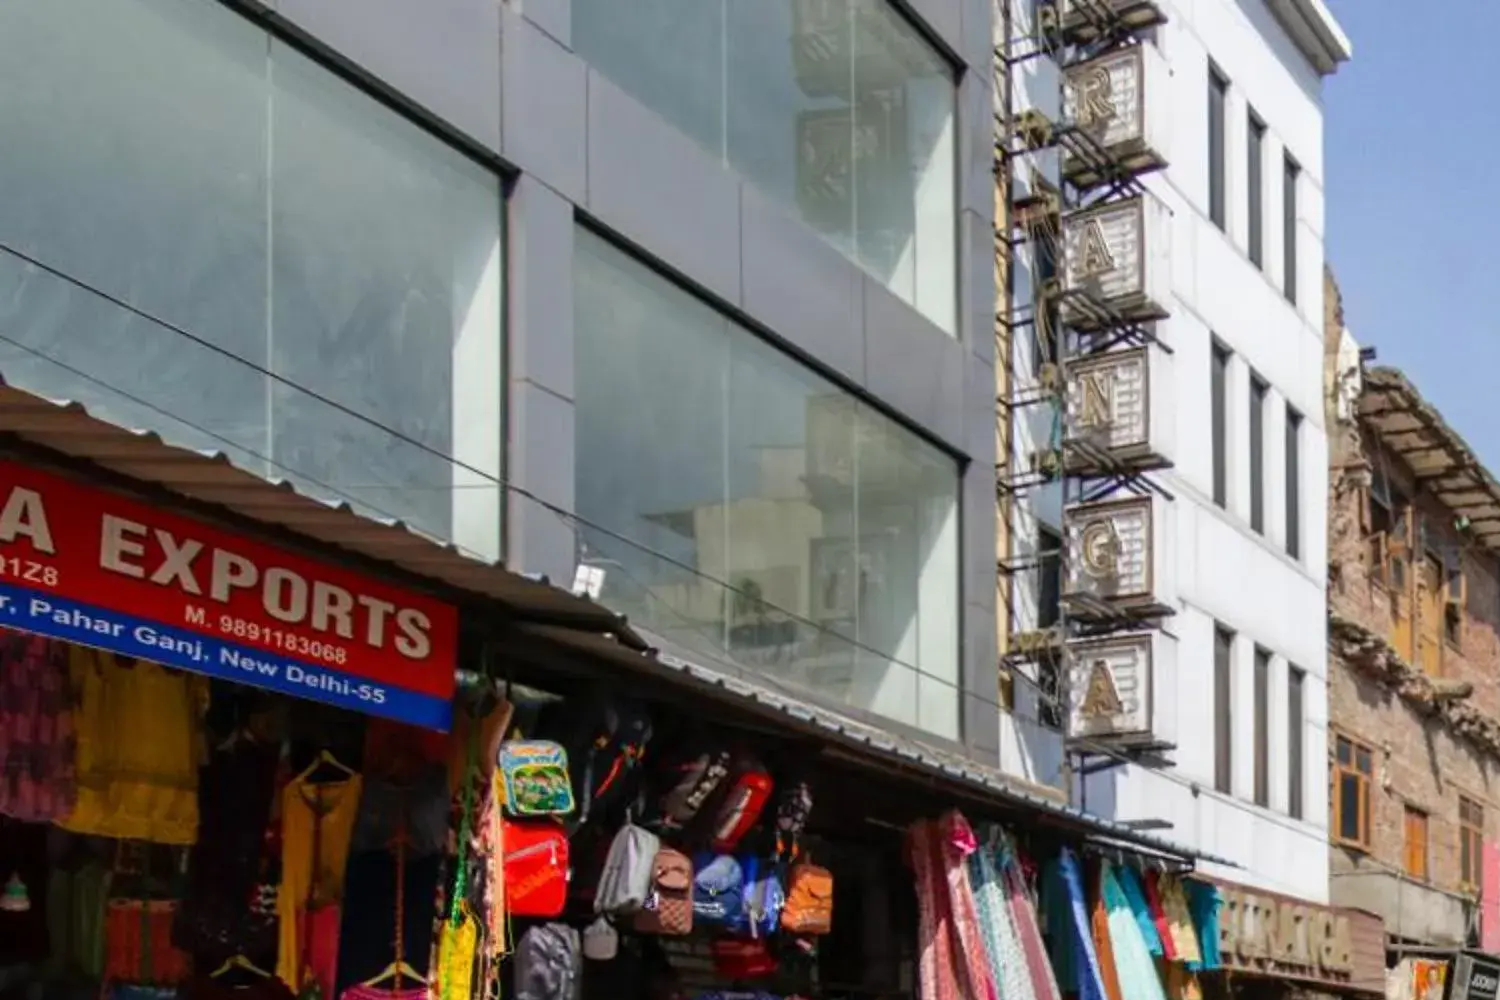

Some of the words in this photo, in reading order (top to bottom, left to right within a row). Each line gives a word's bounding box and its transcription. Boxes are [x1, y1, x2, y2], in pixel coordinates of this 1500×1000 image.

[99, 512, 432, 660] EXPORTS
[185, 605, 212, 627] M.
[219, 615, 347, 665] 9891183068
[29, 598, 126, 637] Pahar
[219, 648, 279, 677] New
[286, 664, 386, 704] Delhi-55
